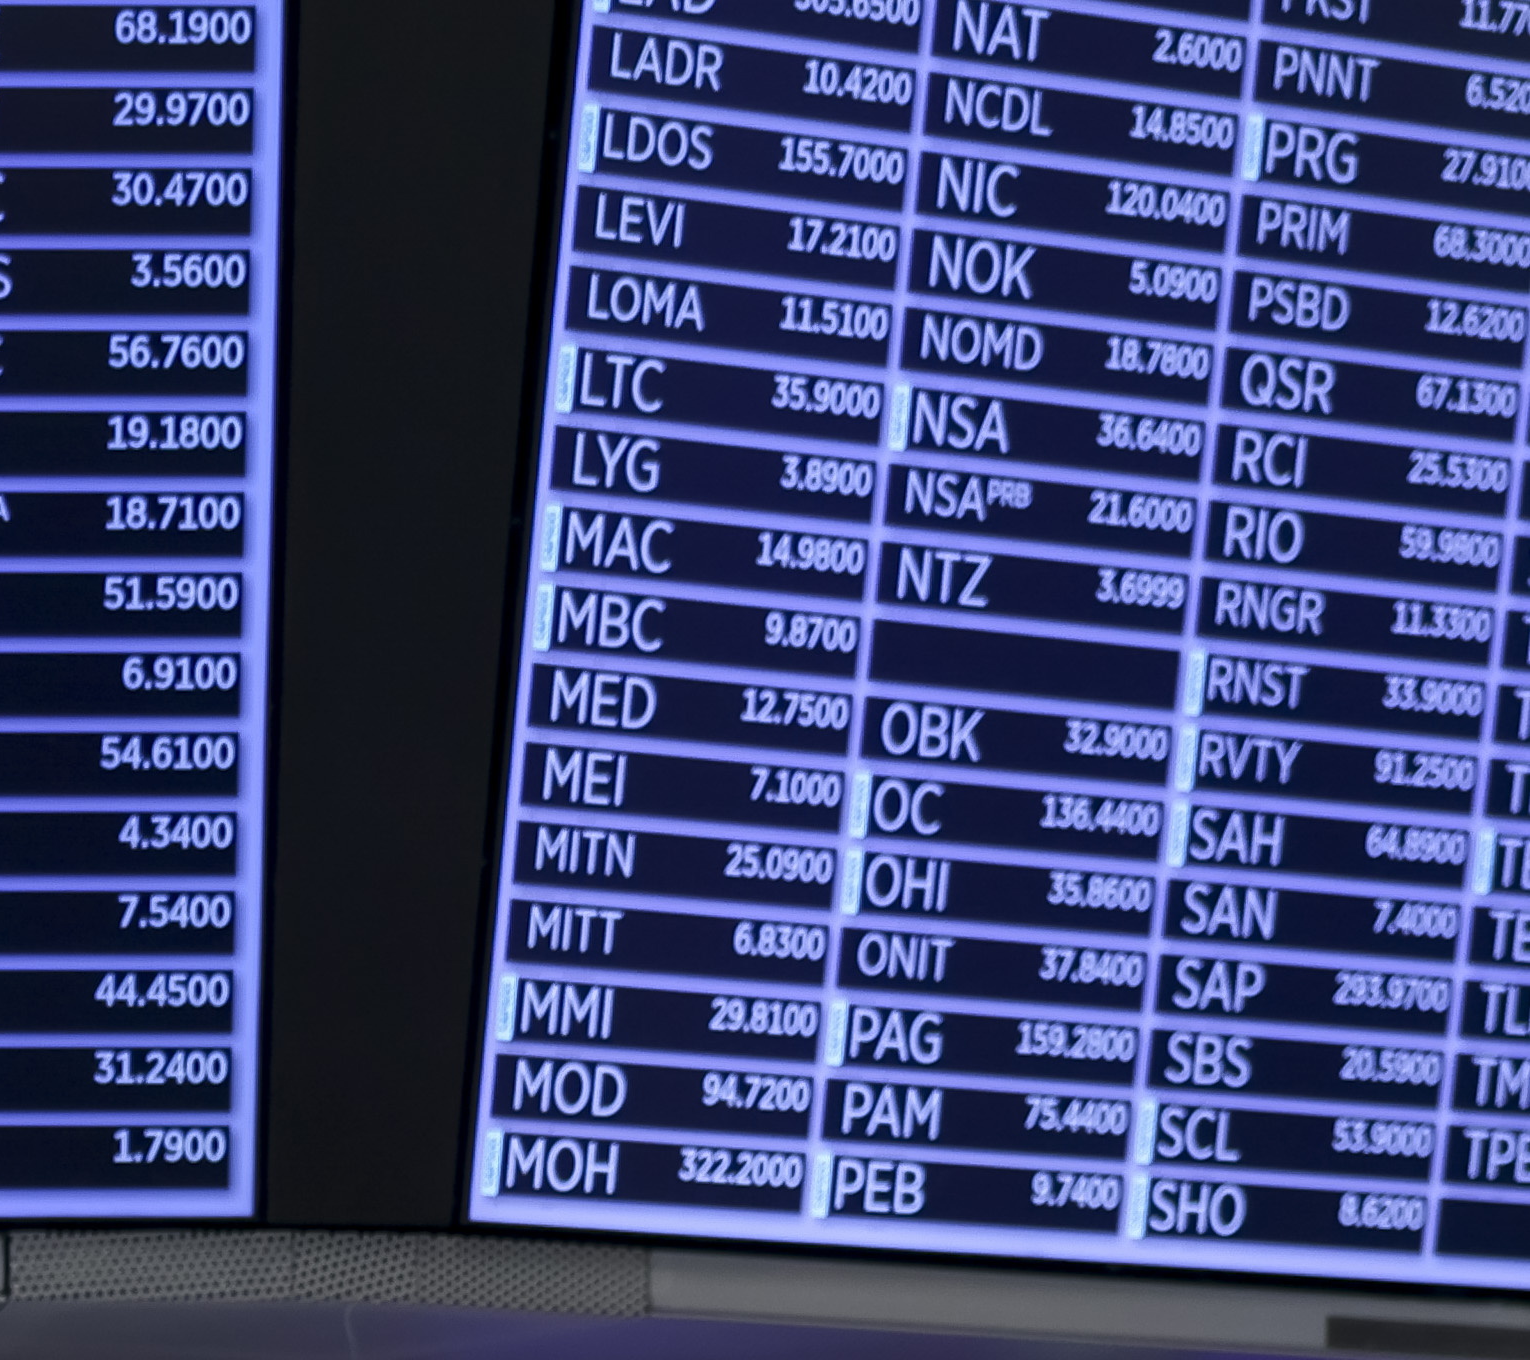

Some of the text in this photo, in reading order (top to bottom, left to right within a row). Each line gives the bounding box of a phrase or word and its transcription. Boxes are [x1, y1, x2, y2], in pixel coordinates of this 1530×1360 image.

[114, 8, 253, 45] 68.1900
[952, 0, 1241, 73] NAT 2.6000
[609, 31, 911, 106] LADR 10.4200
[602, 111, 903, 185] LDOS 155.7000
[935, 156, 1224, 228] NIC 120.0400
[594, 191, 895, 263] LEVI 17.2100
[130, 251, 248, 289] 3.5600
[928, 233, 1215, 304] NOK 5.0900
[579, 350, 878, 420] LTC 35.9000
[1239, 352, 1337, 415] QSR
[106, 414, 244, 450] 19.1800
[571, 430, 870, 498] LYG 3.8900
[896, 545, 1182, 610] NTZ 3.6999
[556, 588, 854, 654] MBC 9.8700
[121, 655, 239, 691] 6.9100
[549, 667, 846, 731] MED 12.7500
[118, 813, 235, 850] 4.3400
[872, 778, 1157, 838] OC 136.4400
[534, 824, 831, 885] MITN 25.0900
[1179, 882, 1279, 941] SAN
[519, 981, 815, 1040] MMI 29.8100
[93, 1049, 229, 1085] 31.2400
[504, 1135, 800, 1195] MOH 322.2000
[833, 1158, 1117, 1215] PEB 9.7400
